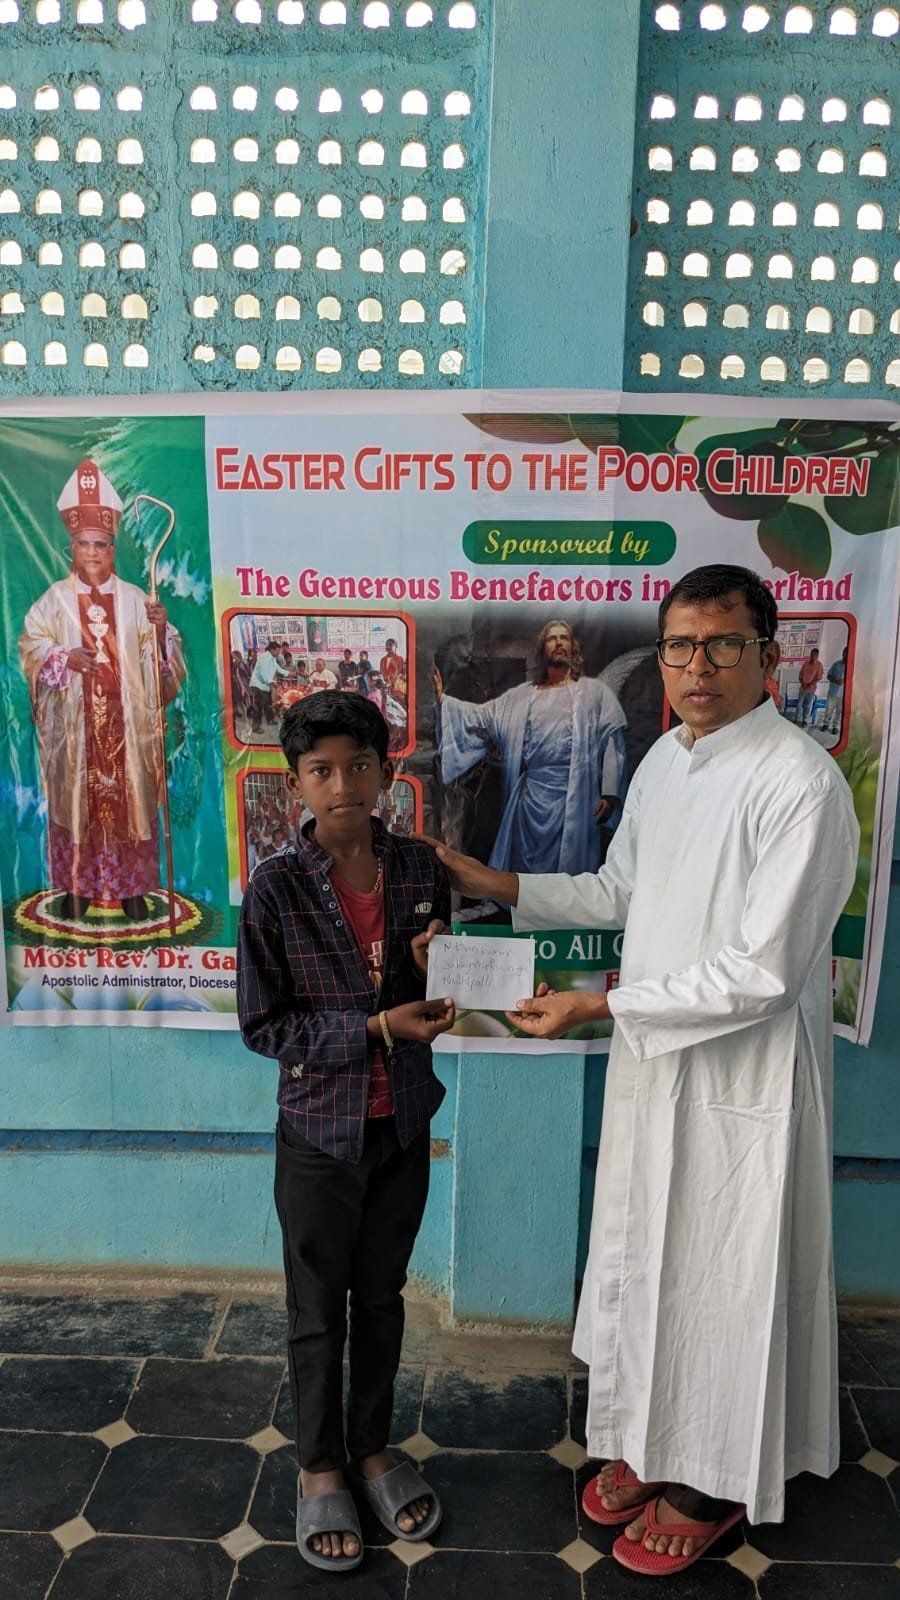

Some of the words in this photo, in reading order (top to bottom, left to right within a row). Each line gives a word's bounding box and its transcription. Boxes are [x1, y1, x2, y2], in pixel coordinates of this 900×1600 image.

[215, 447, 346, 490] EASTER
[354, 447, 455, 490] GIFTS
[464, 453, 512, 491] TO
[521, 453, 589, 491] THE
[597, 446, 698, 492] POOR
[706, 449, 870, 496] CHILDREN
[484, 529, 615, 561] Sponsored
[620, 530, 651, 562] by
[236, 567, 291, 597] The
[299, 568, 441, 600] Generous
[450, 570, 633, 602] Benefactors
[763, 572, 853, 601] erland
[24, 947, 88, 969] Most
[96, 947, 148, 969] Rev.
[157, 948, 194, 969] Dr.
[202, 949, 238, 971] Ga
[565, 934, 603, 960] All
[41, 973, 99, 989] Apostolic
[102, 974, 186, 990] Administrator,
[189, 975, 238, 989] Diocese
